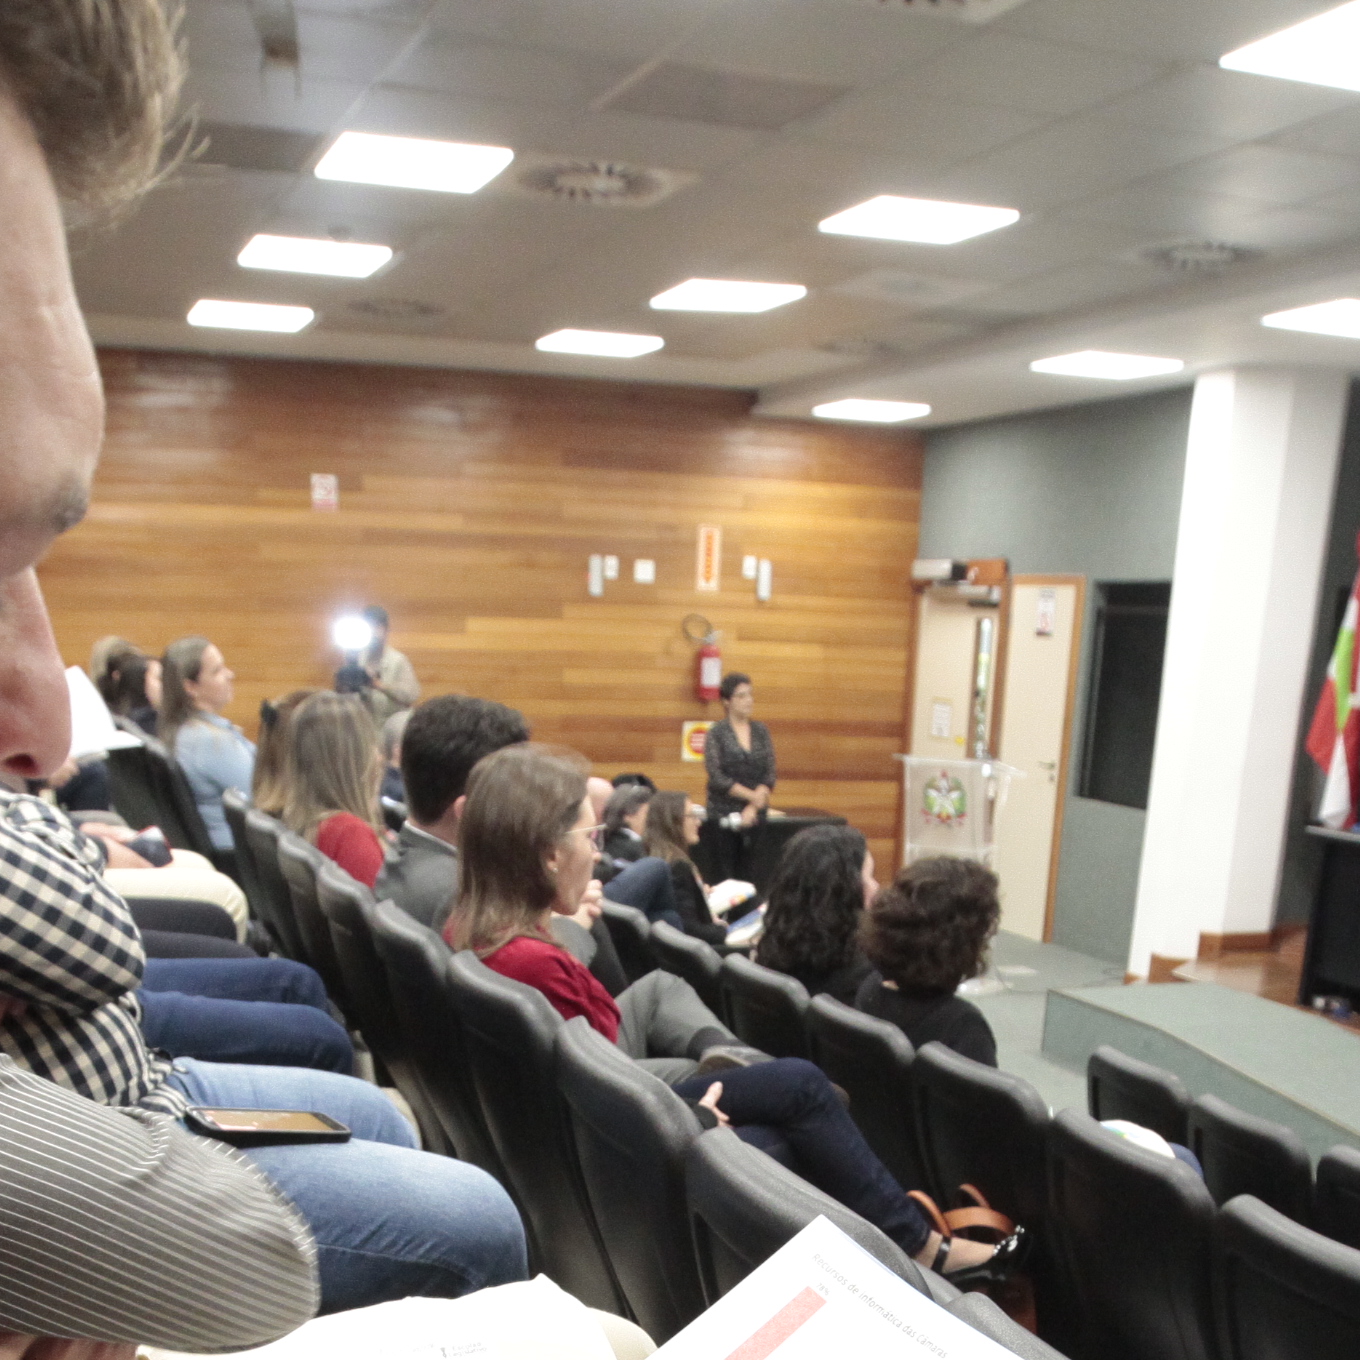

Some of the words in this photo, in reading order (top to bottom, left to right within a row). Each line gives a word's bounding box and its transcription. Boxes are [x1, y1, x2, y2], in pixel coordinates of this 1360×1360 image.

[810, 1252, 850, 1287] Recursos
[857, 1291, 904, 1330] informática
[900, 1323, 918, 1339] das
[915, 1333, 948, 1360] Câmaras
